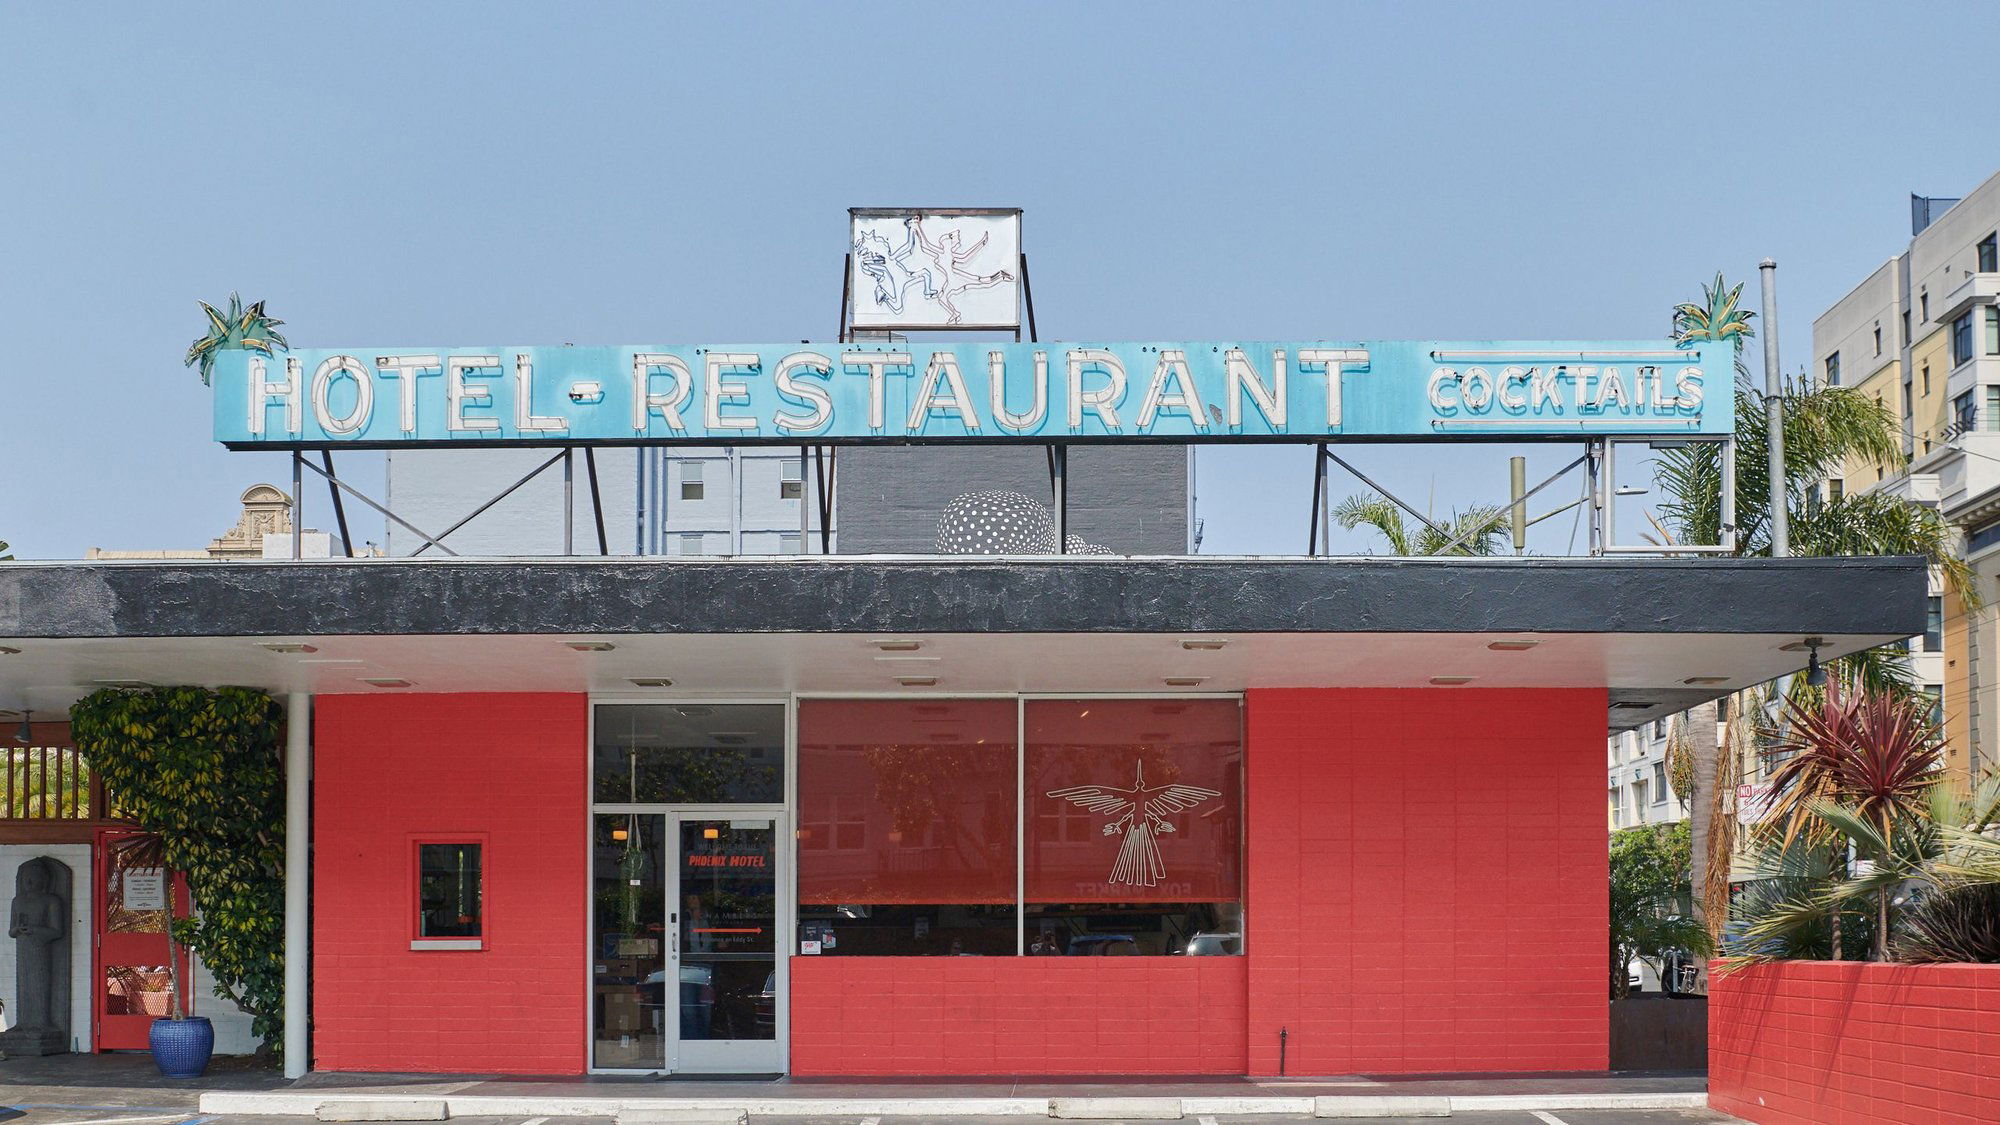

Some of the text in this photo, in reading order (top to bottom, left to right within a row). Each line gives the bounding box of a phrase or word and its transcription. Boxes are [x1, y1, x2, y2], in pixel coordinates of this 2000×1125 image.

[247, 353, 570, 434] HOTEL
[632, 348, 1371, 431] RESTAURANT
[1427, 366, 1704, 409] COCKTAILS
[1740, 785, 1751, 797] NO
[688, 855, 727, 867] PHOENIX
